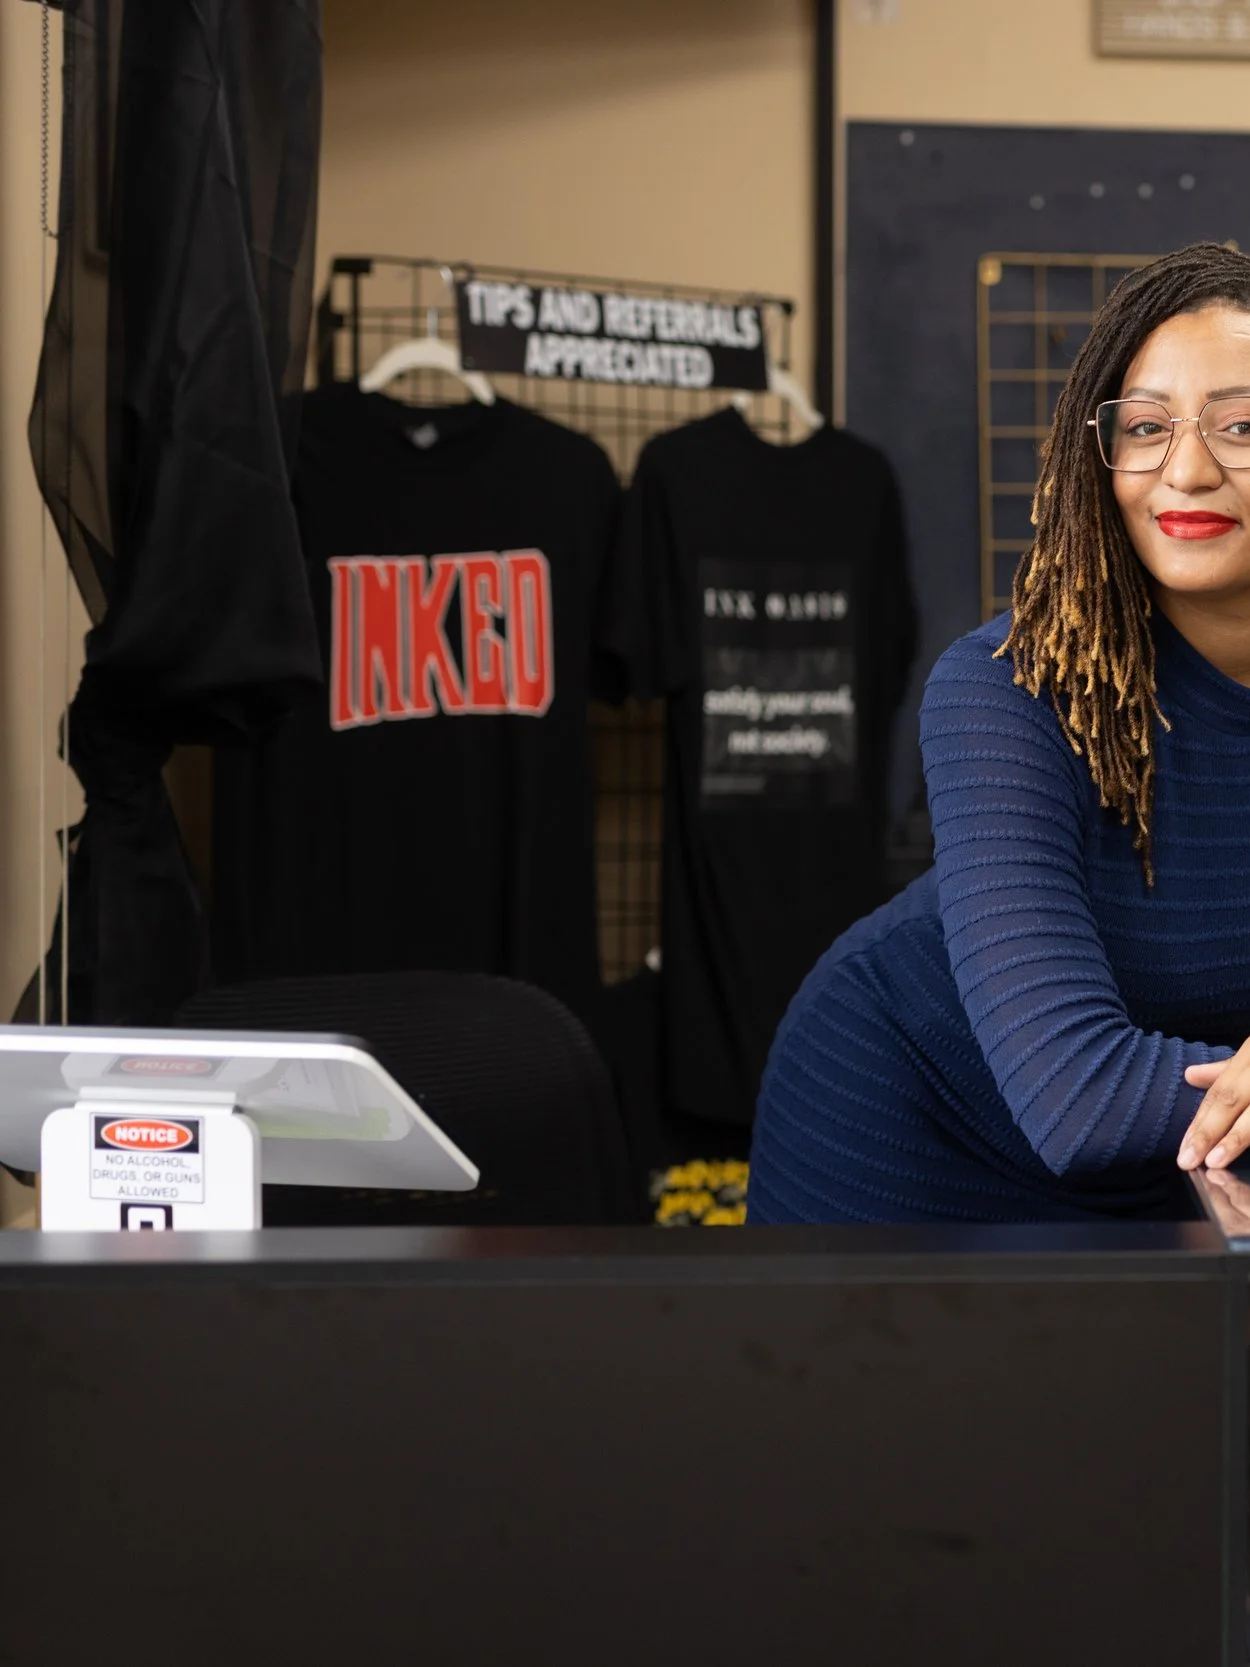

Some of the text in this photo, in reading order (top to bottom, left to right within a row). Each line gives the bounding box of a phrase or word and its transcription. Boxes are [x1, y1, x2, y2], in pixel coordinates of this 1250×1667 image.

[466, 281, 761, 349] TIPS AND REFERRALS
[524, 333, 714, 389] APPRECIATED
[704, 587, 849, 621] INK OASIS
[328, 548, 554, 731] INKED
[114, 1126, 179, 1144] NOTICE
[106, 1154, 190, 1170] NO ALCOHOL,
[93, 1169, 201, 1185] DRUGS, OR GUNS
[118, 1186, 179, 1199] ALLOWED
